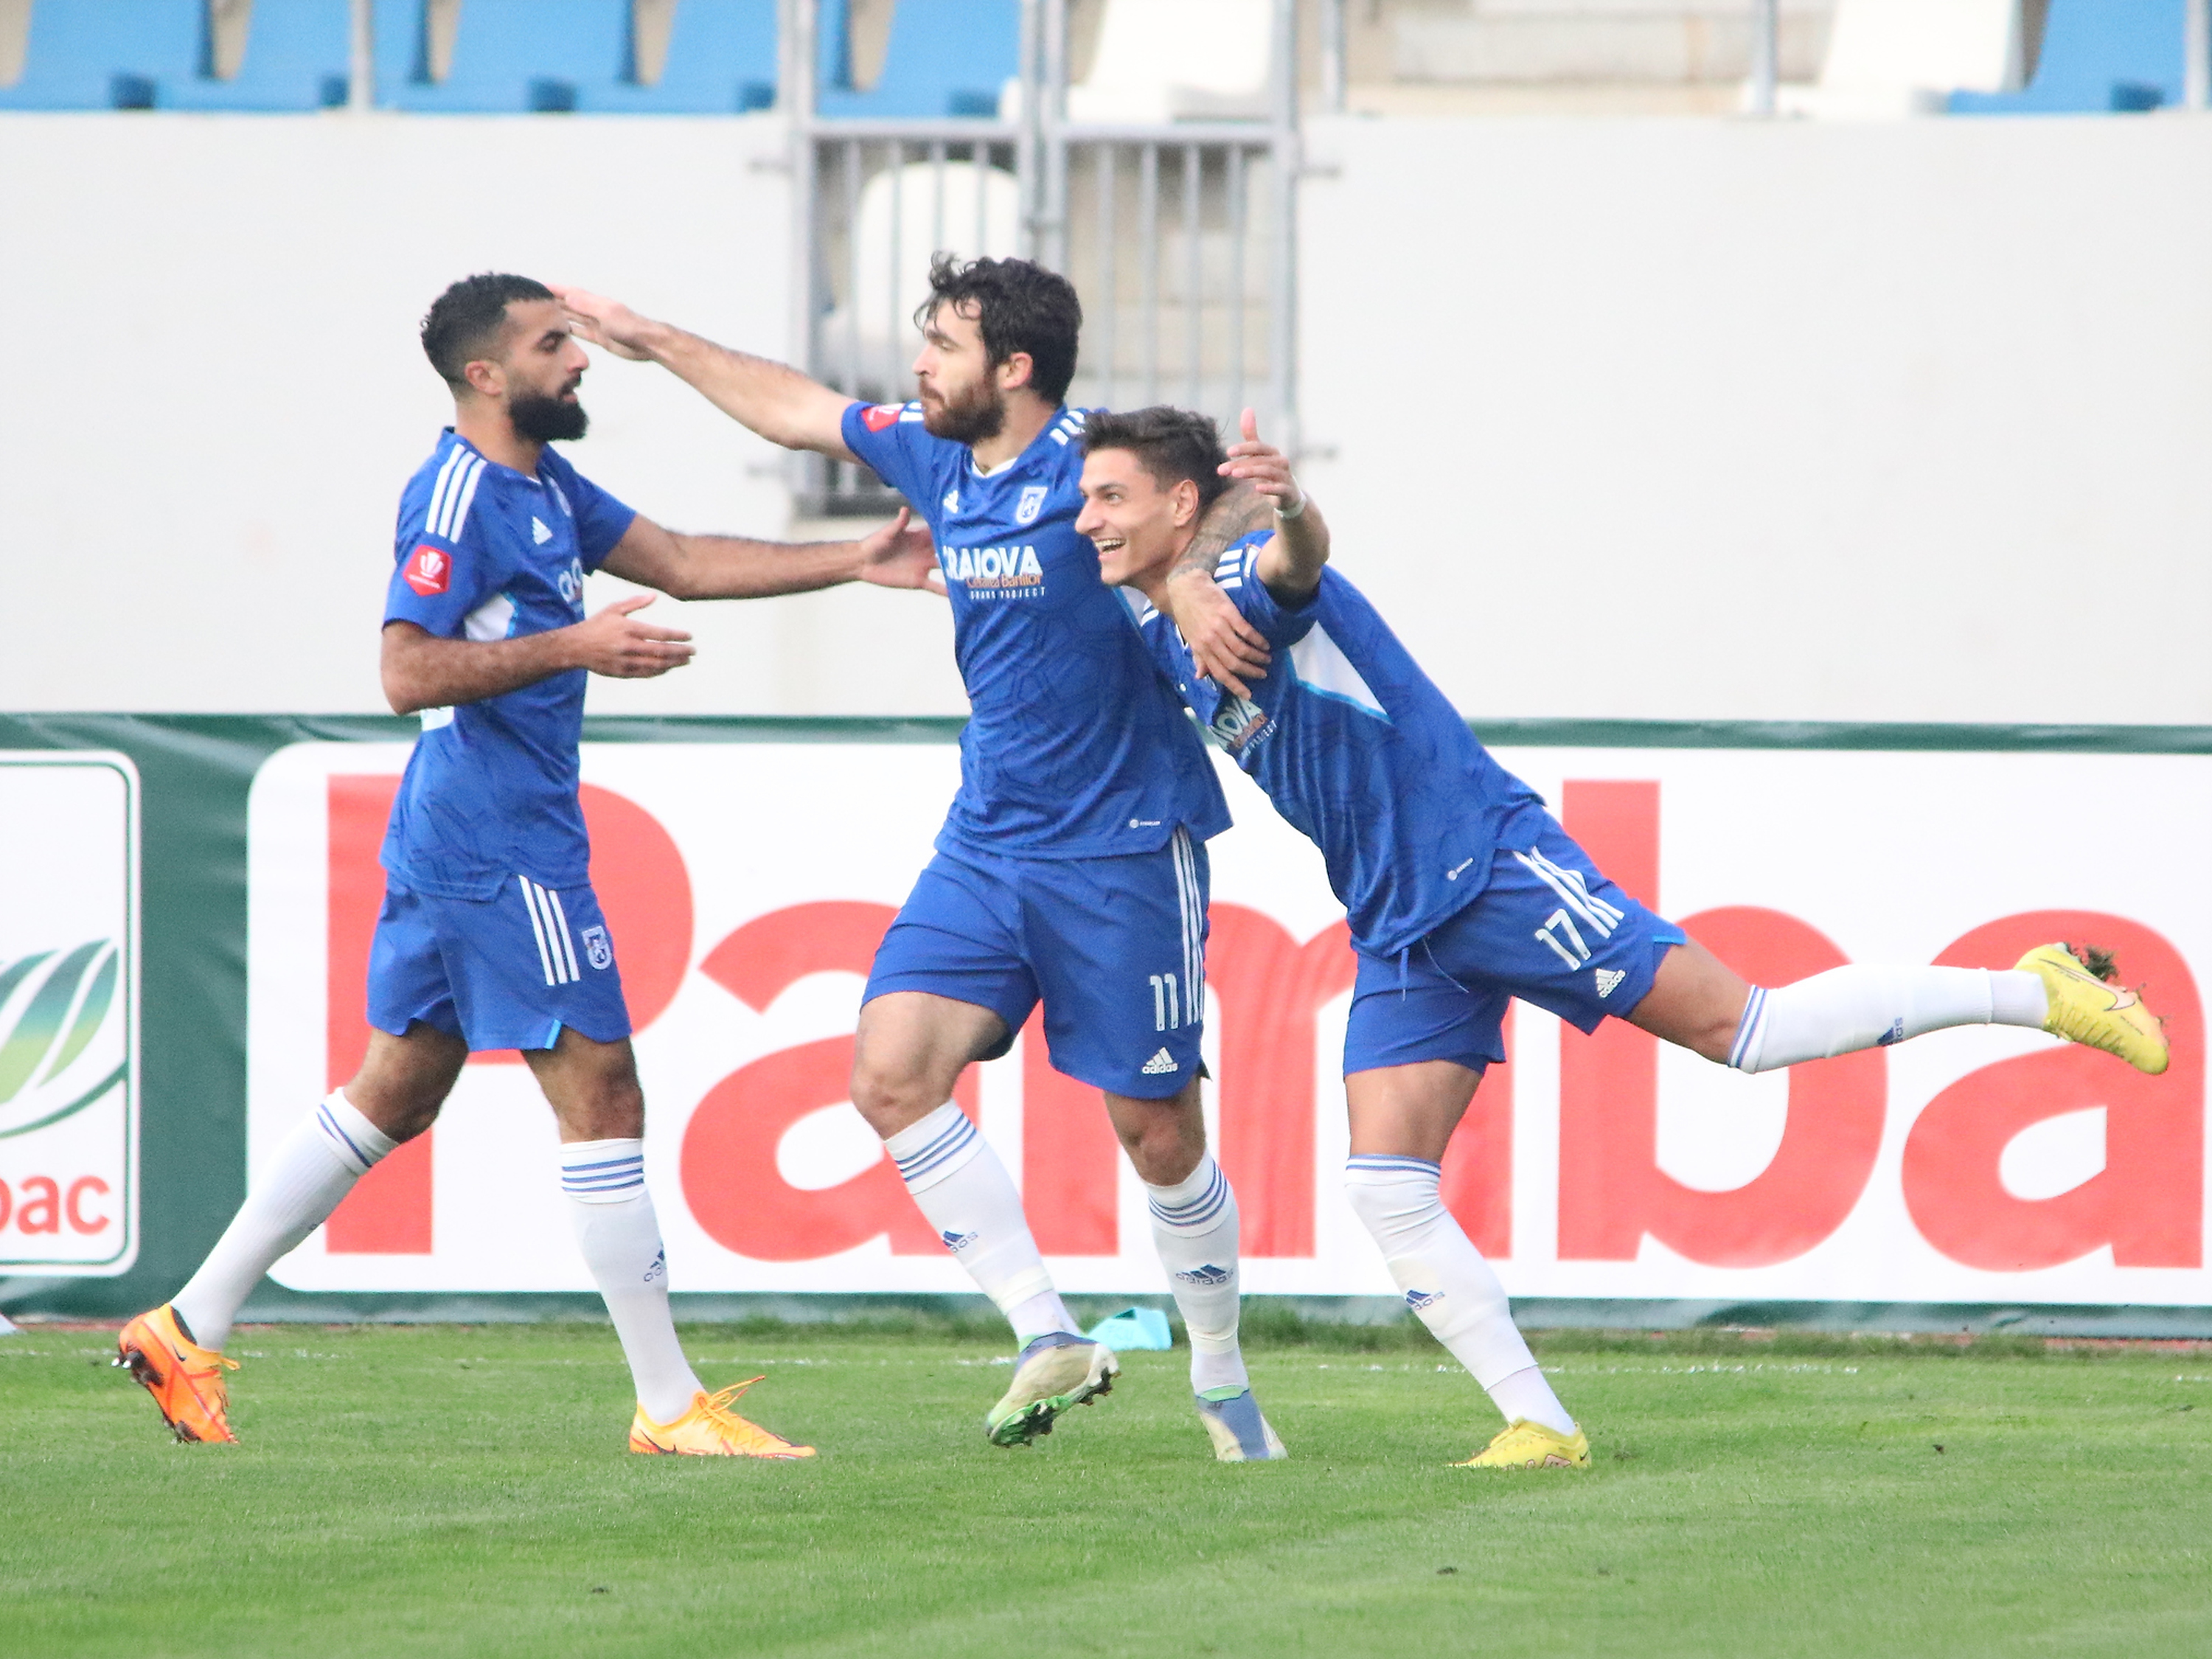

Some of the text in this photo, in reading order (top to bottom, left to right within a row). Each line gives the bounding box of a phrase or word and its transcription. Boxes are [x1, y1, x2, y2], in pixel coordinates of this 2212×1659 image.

[942, 546, 1043, 580] RAIOVA
[1000, 587, 1046, 599] PROJECT
[1535, 908, 1592, 972] 17
[1599, 970, 1626, 998] adidas
[1150, 973, 1178, 1031] 11
[1142, 1062, 1178, 1074] adidas
[0, 1175, 110, 1236] ac
